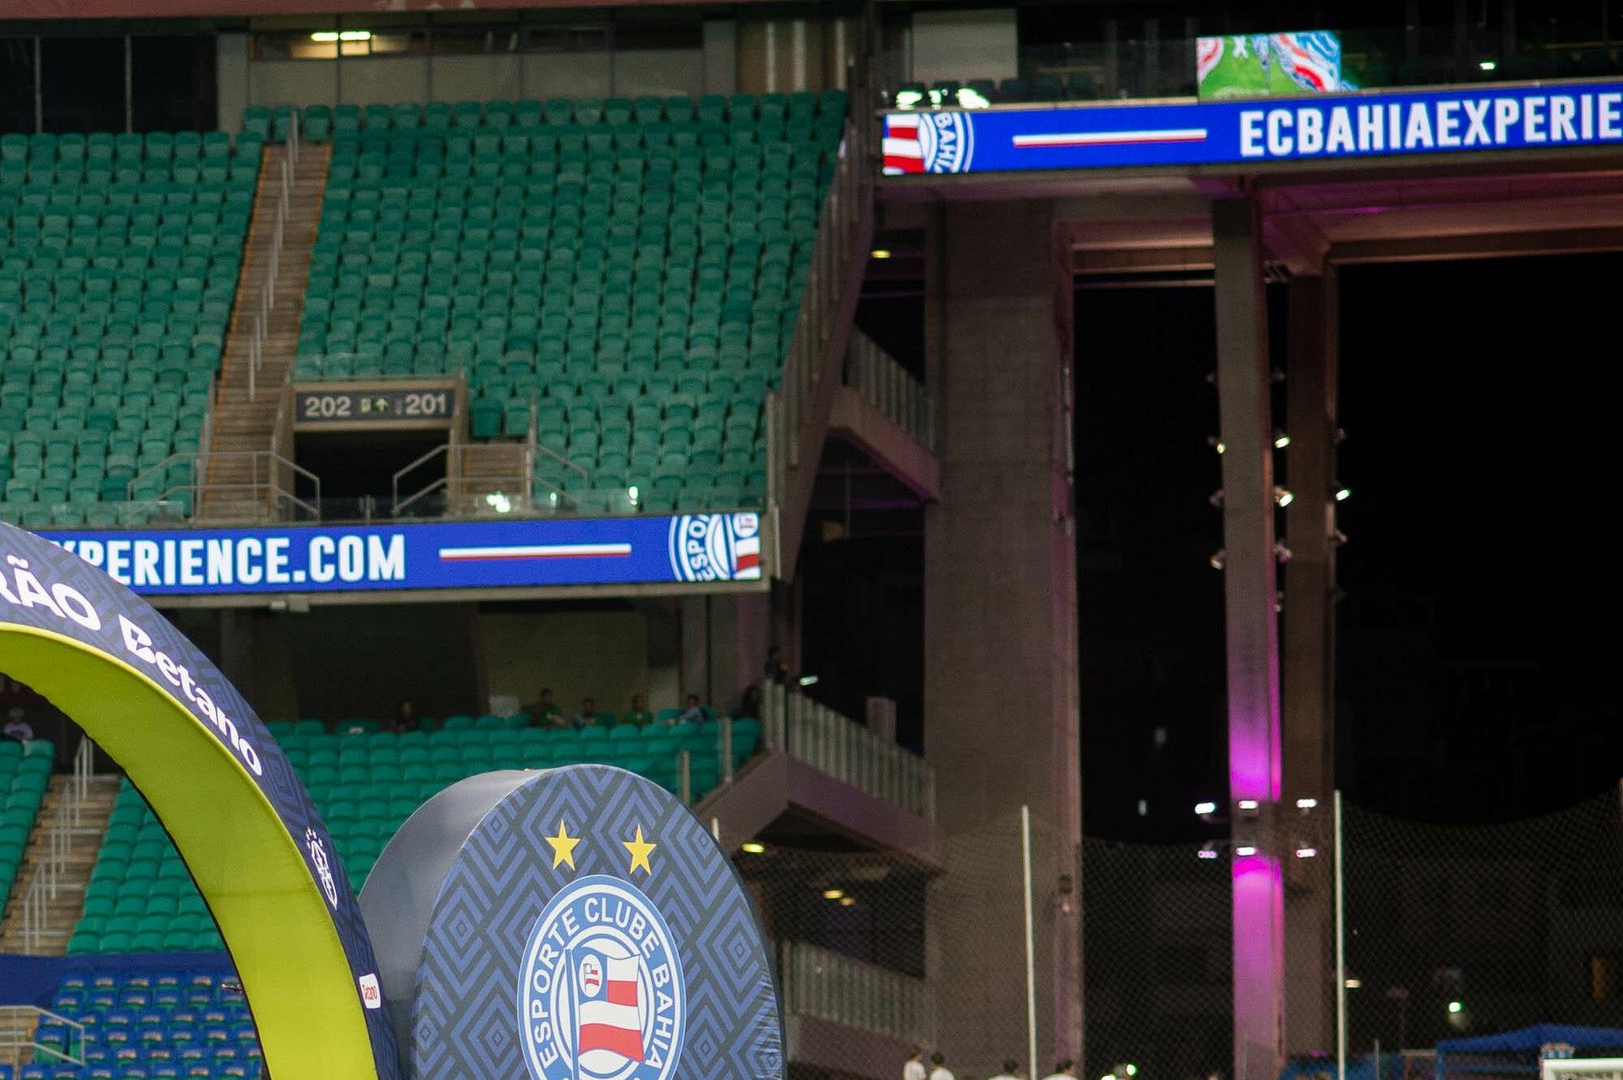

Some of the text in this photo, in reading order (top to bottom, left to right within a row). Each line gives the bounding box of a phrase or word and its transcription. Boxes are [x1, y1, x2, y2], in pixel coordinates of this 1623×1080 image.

[305, 397, 351, 417] 202
[405, 393, 446, 415] 201
[118, 614, 262, 776] Betano
[531, 897, 673, 1070] ESPORTE CLUBE BAHIA
